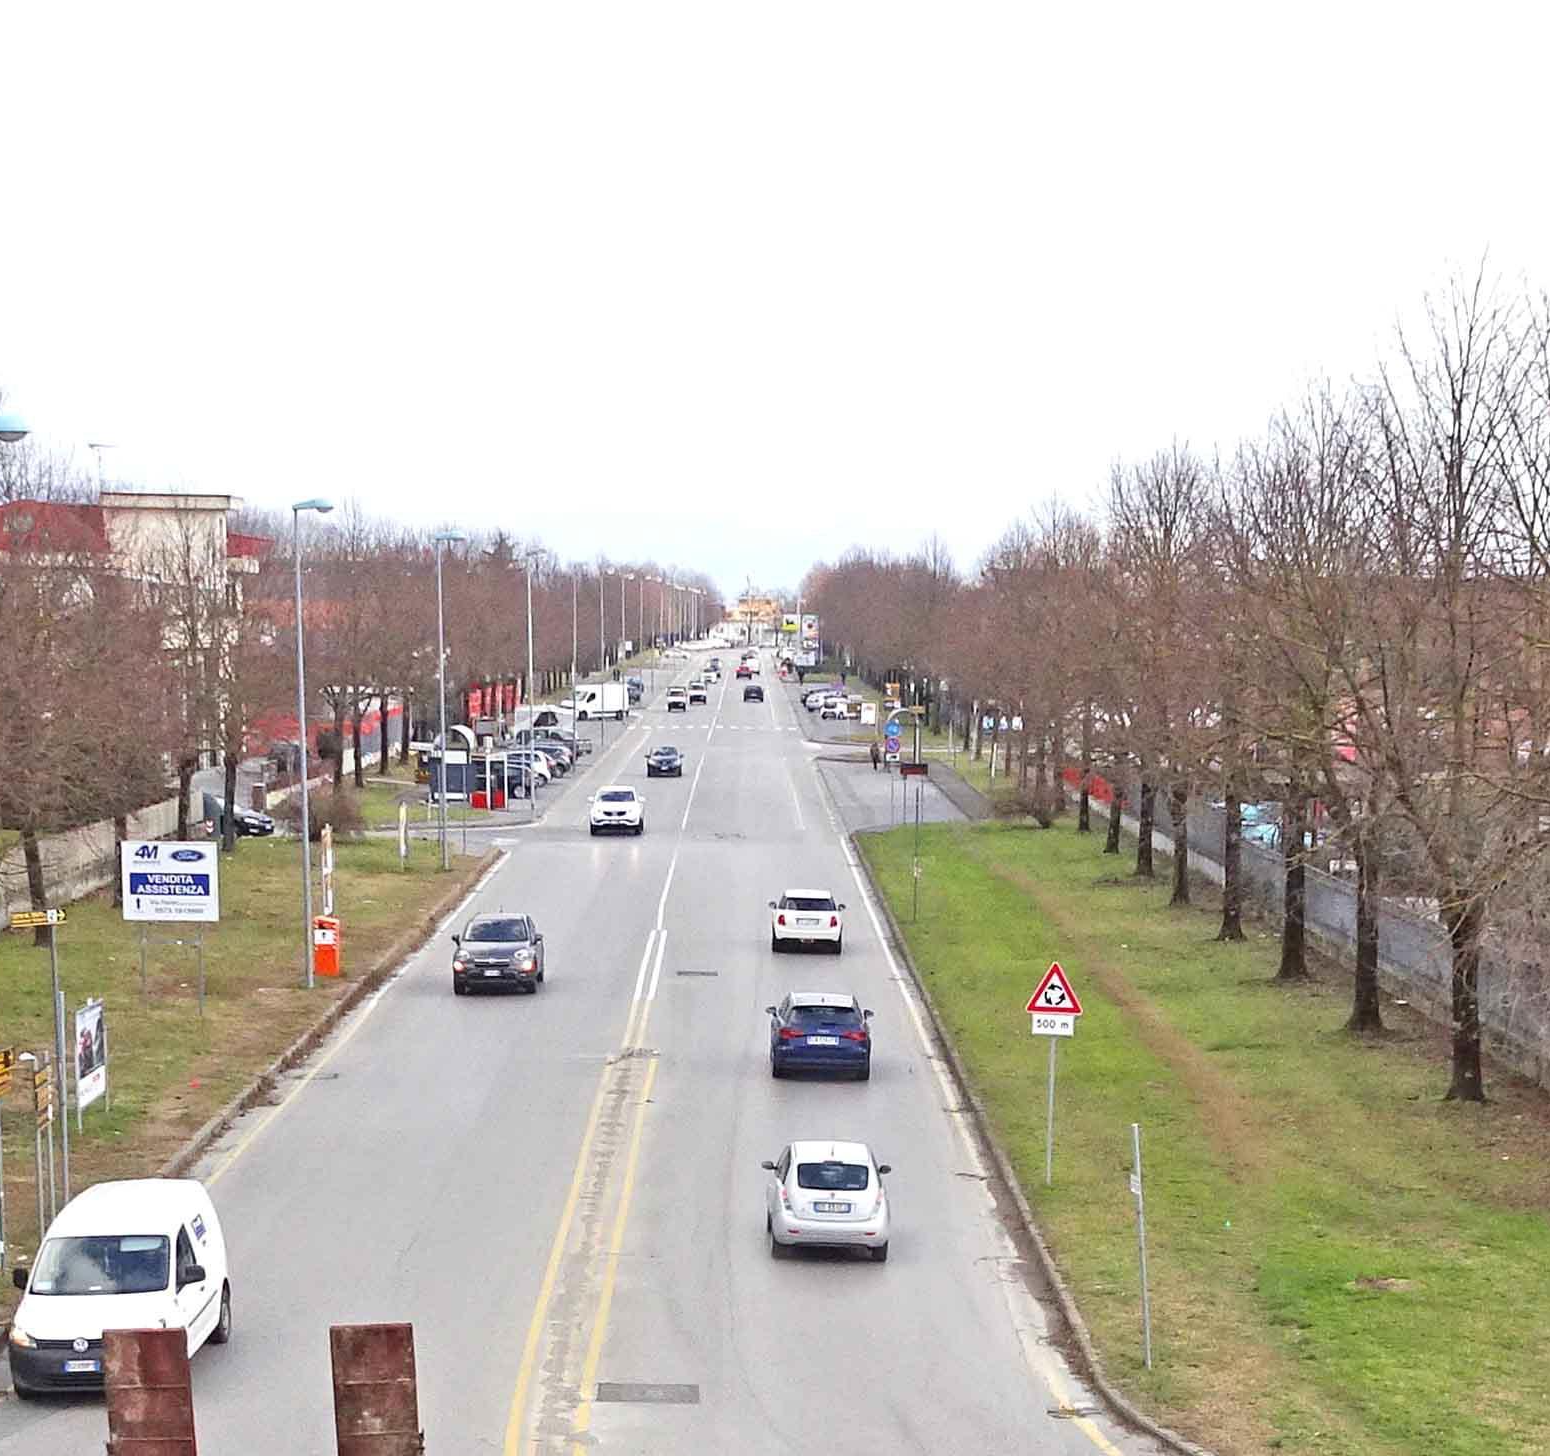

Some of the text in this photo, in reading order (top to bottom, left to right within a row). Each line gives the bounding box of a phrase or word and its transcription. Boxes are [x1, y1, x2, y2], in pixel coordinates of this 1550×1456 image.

[135, 845, 158, 859] 4M
[147, 874, 194, 884] VENDITA
[137, 885, 205, 895] ASSISTENZA
[1036, 1019, 1056, 1029] 500
